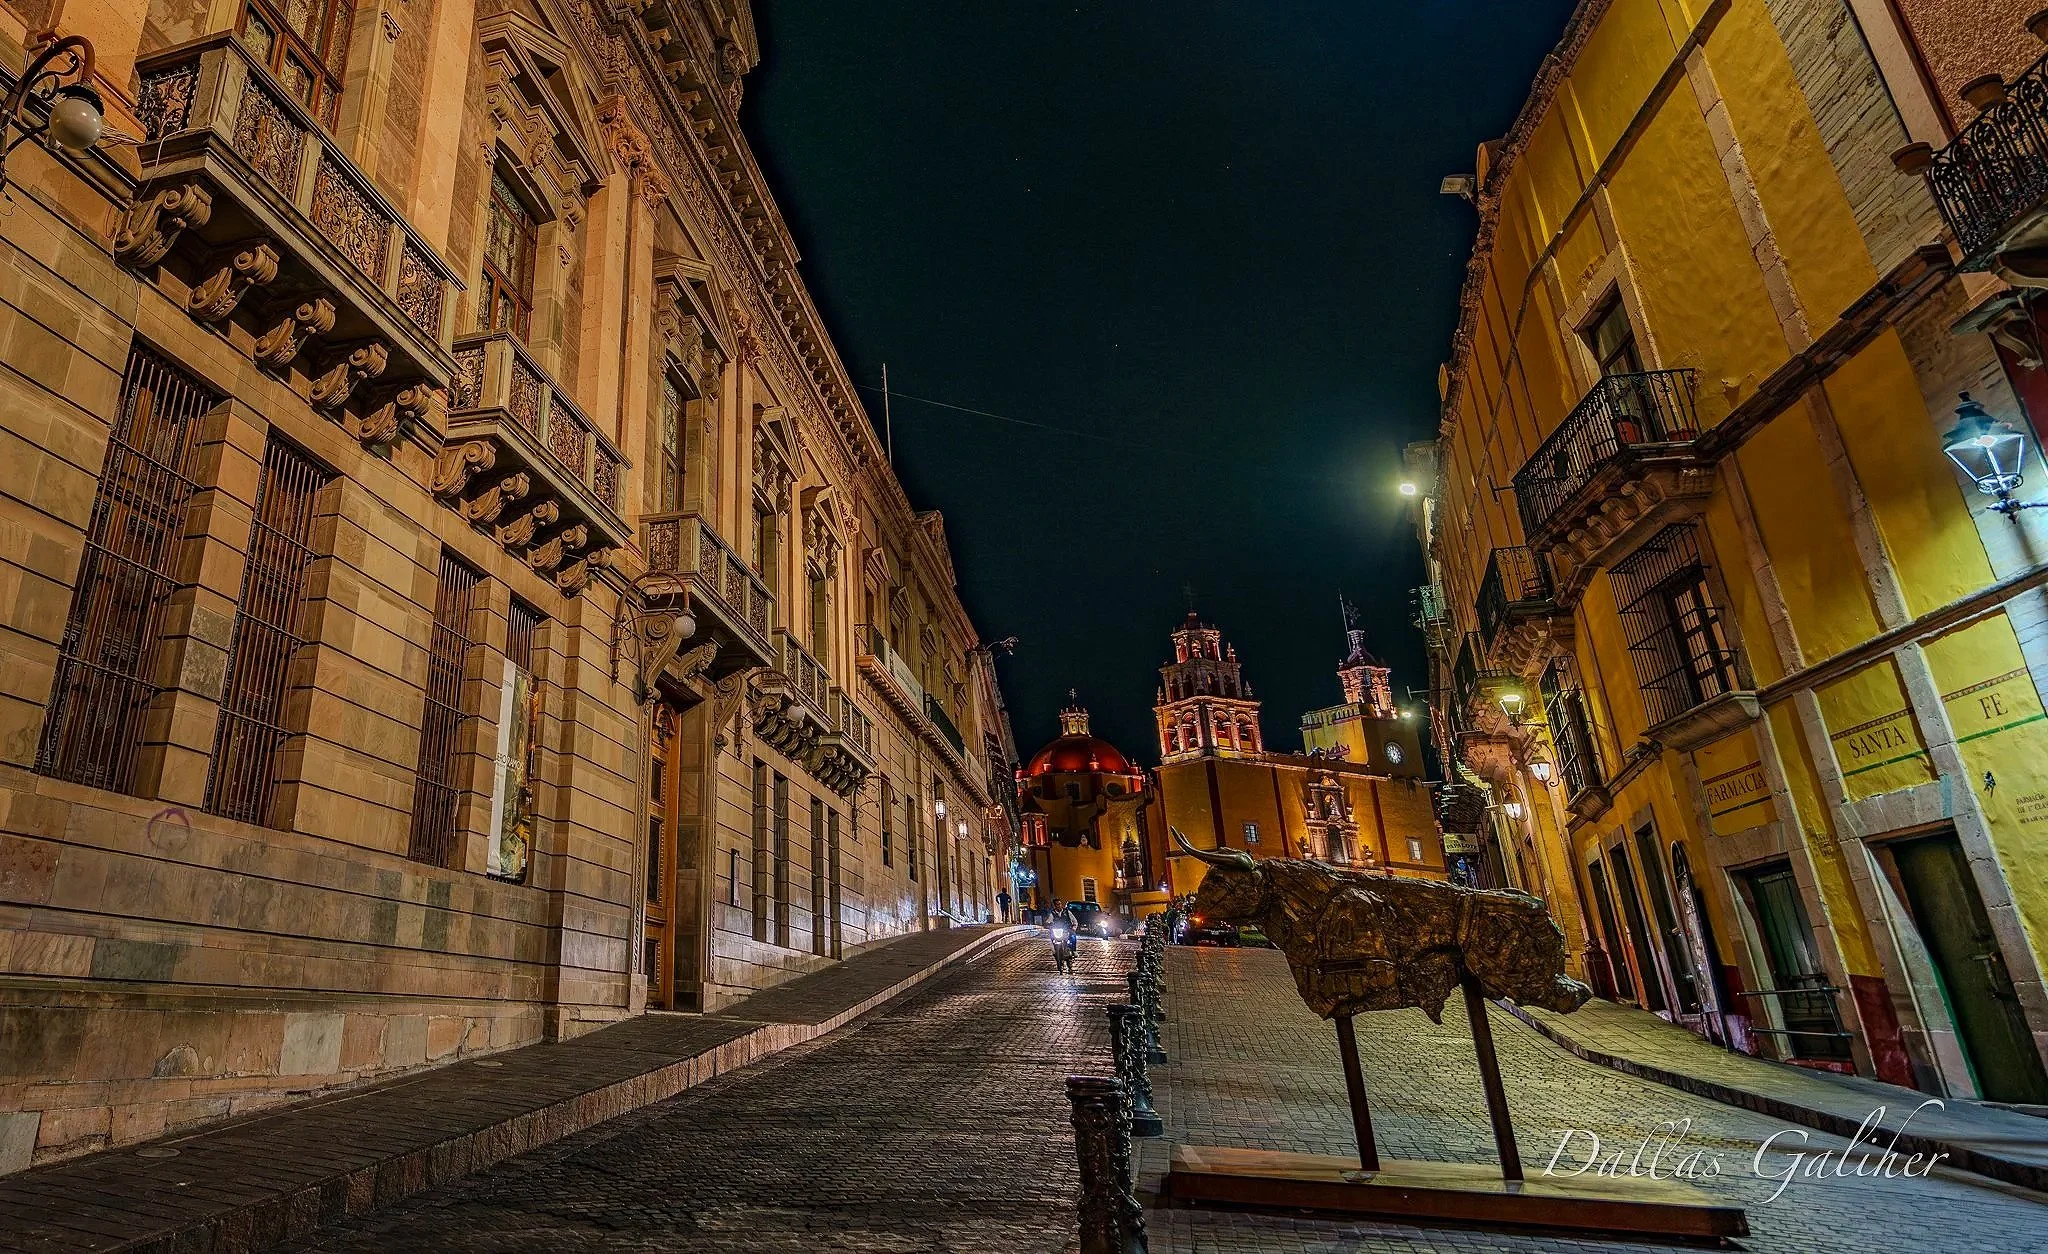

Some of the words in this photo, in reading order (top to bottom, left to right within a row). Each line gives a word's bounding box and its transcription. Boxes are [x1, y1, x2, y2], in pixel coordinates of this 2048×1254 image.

[1706, 771, 1768, 805] FARMACIA
[1850, 723, 1906, 759] SANTA
[1978, 692, 2008, 720] FE
